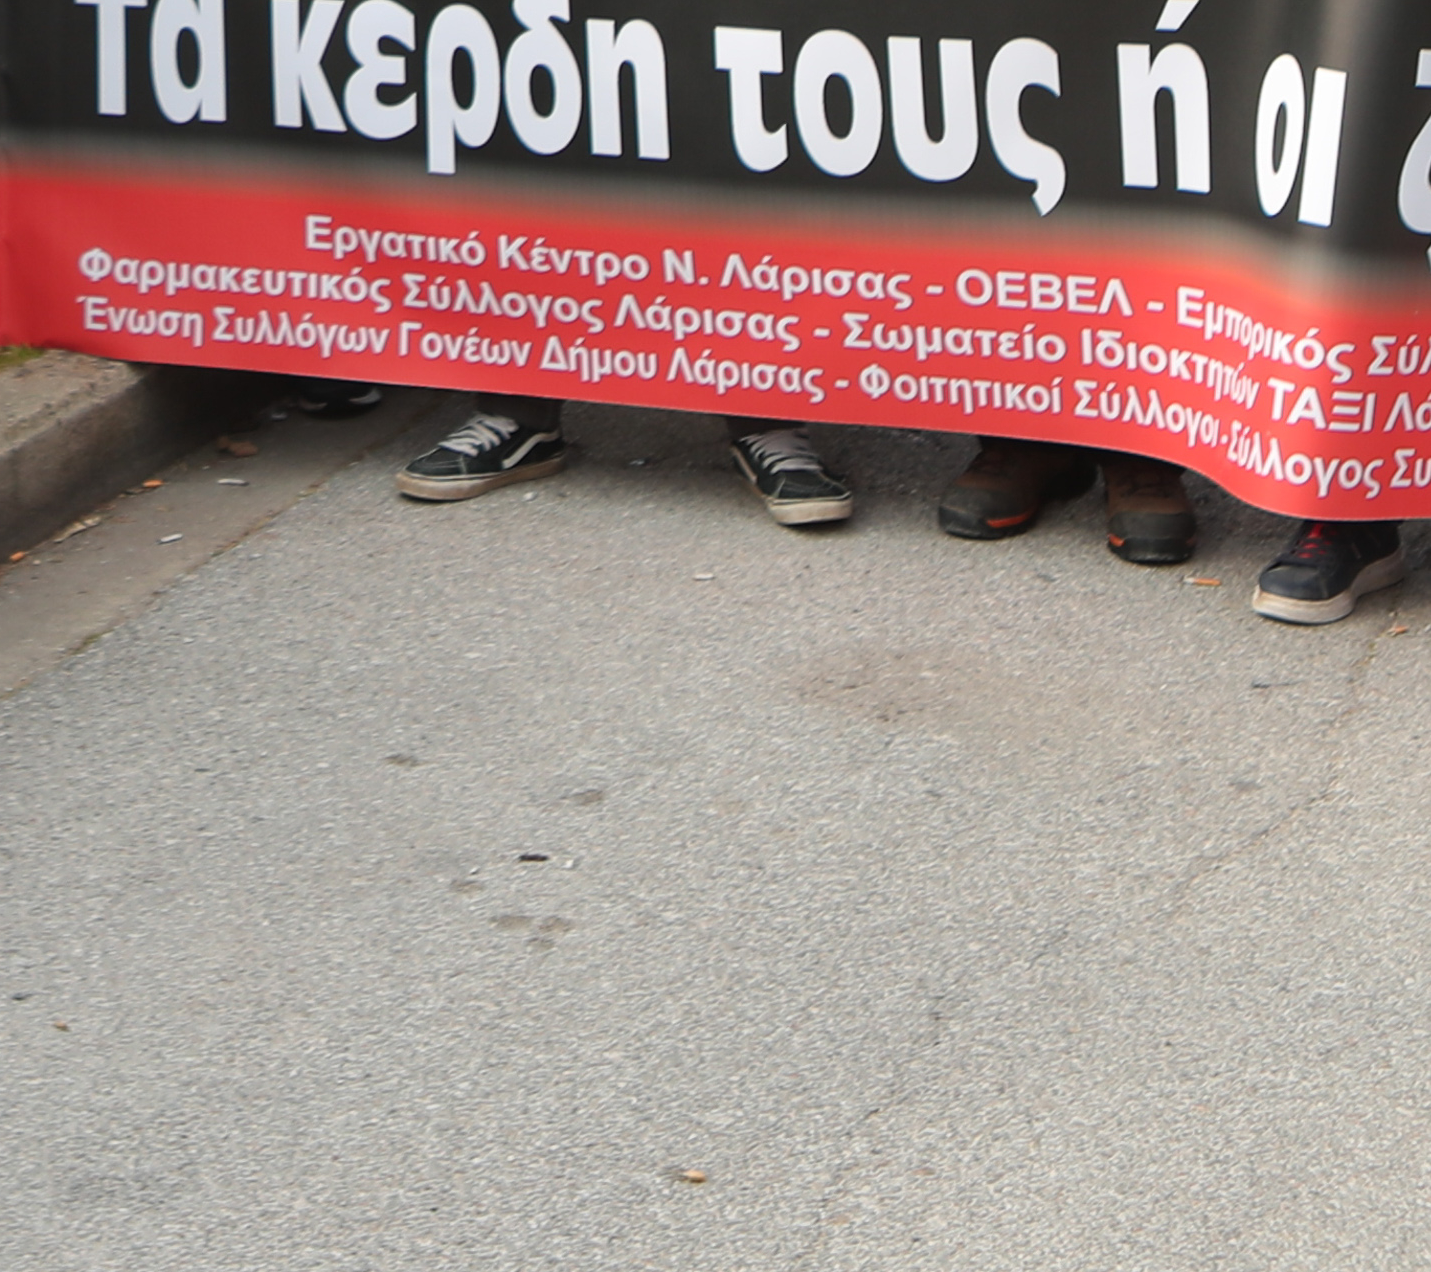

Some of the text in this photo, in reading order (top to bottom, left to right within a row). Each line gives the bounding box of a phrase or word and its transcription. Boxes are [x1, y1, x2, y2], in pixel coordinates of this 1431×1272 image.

[714, 25, 1067, 218] τους
[1256, 53, 1349, 228] οι
[76, 295, 204, 347] Ένωση
[212, 303, 390, 357] Συλλόγων
[398, 319, 532, 369] Γονέων
[539, 331, 657, 383] Δήμου
[666, 344, 825, 404] Λάρισας
[858, 363, 1063, 416] Φοιτητικοί
[1073, 378, 1221, 447] Σύλλογοι
[1227, 425, 1382, 498] Σύλλογος
[78, 245, 392, 313] Φαρμακευτικός
[402, 271, 605, 333] Σύλλογος
[614, 294, 800, 352] Λάρισας
[841, 311, 1067, 364] Σωματείο
[1082, 327, 1259, 411] Ιδιοκτητών
[1266, 376, 1375, 434] ΤΑΞΙ
[305, 214, 487, 268] Εργατικό
[498, 233, 649, 286] Κέντρο
[663, 249, 708, 286] Ν.
[721, 253, 913, 308] Λάρισας
[955, 267, 1134, 317] ΟΕΒΕΛ
[1176, 285, 1355, 383] Εμπορικός
